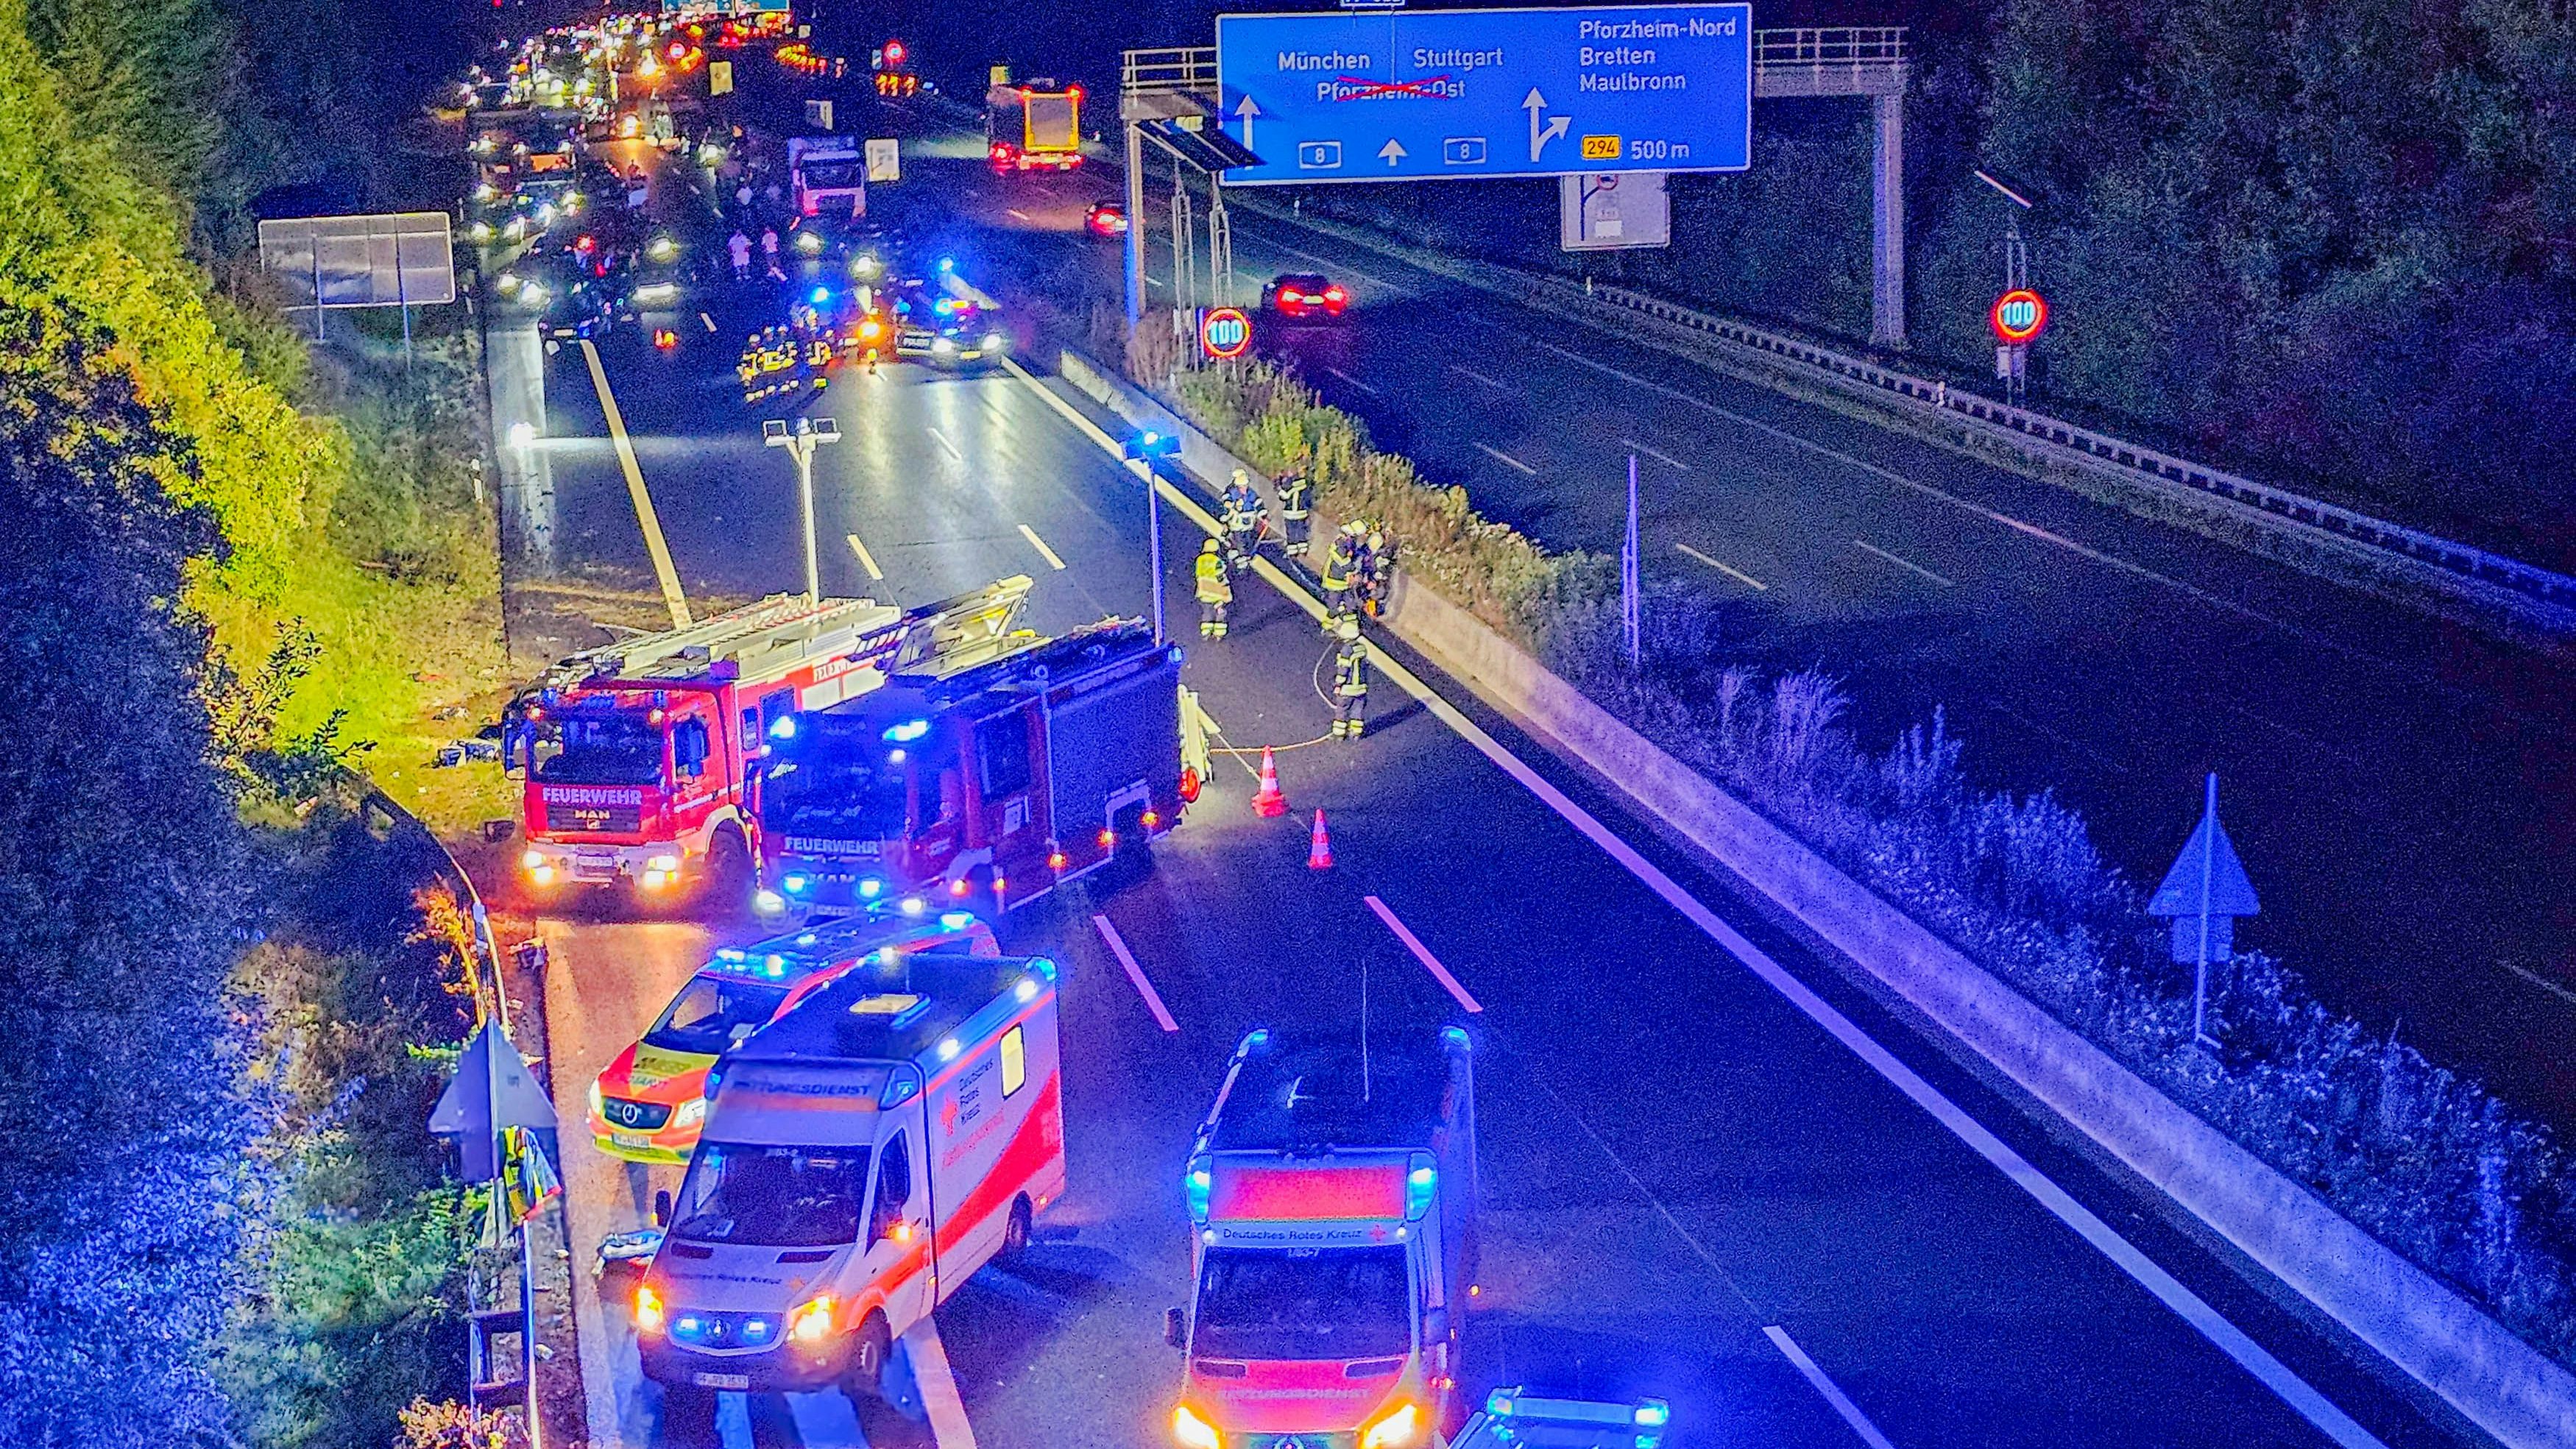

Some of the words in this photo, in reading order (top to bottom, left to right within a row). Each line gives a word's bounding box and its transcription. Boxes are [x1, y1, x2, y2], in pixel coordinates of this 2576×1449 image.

[1579, 16, 1736, 38] Pforzheim-Nord
[1278, 50, 1370, 71] München
[1413, 47, 1504, 71] Stuttgart
[1580, 46, 1656, 66] Bretten
[1579, 72, 1686, 91] Maulbronn
[1314, 147, 1325, 163] 8
[1460, 143, 1470, 159] 8
[1588, 140, 1615, 155] 294
[1631, 140, 1667, 160] 500
[1671, 144, 1689, 159] m
[2002, 301, 2036, 326] 100
[1207, 319, 1244, 344] 100
[542, 787, 642, 804] FEUERWEHR
[575, 809, 610, 819] MAN
[784, 837, 880, 854] FEUERWEHR
[1223, 1228, 1285, 1240] Deutsches
[1289, 1230, 1323, 1240] Rotes
[1327, 1229, 1362, 1239] Kreuz
